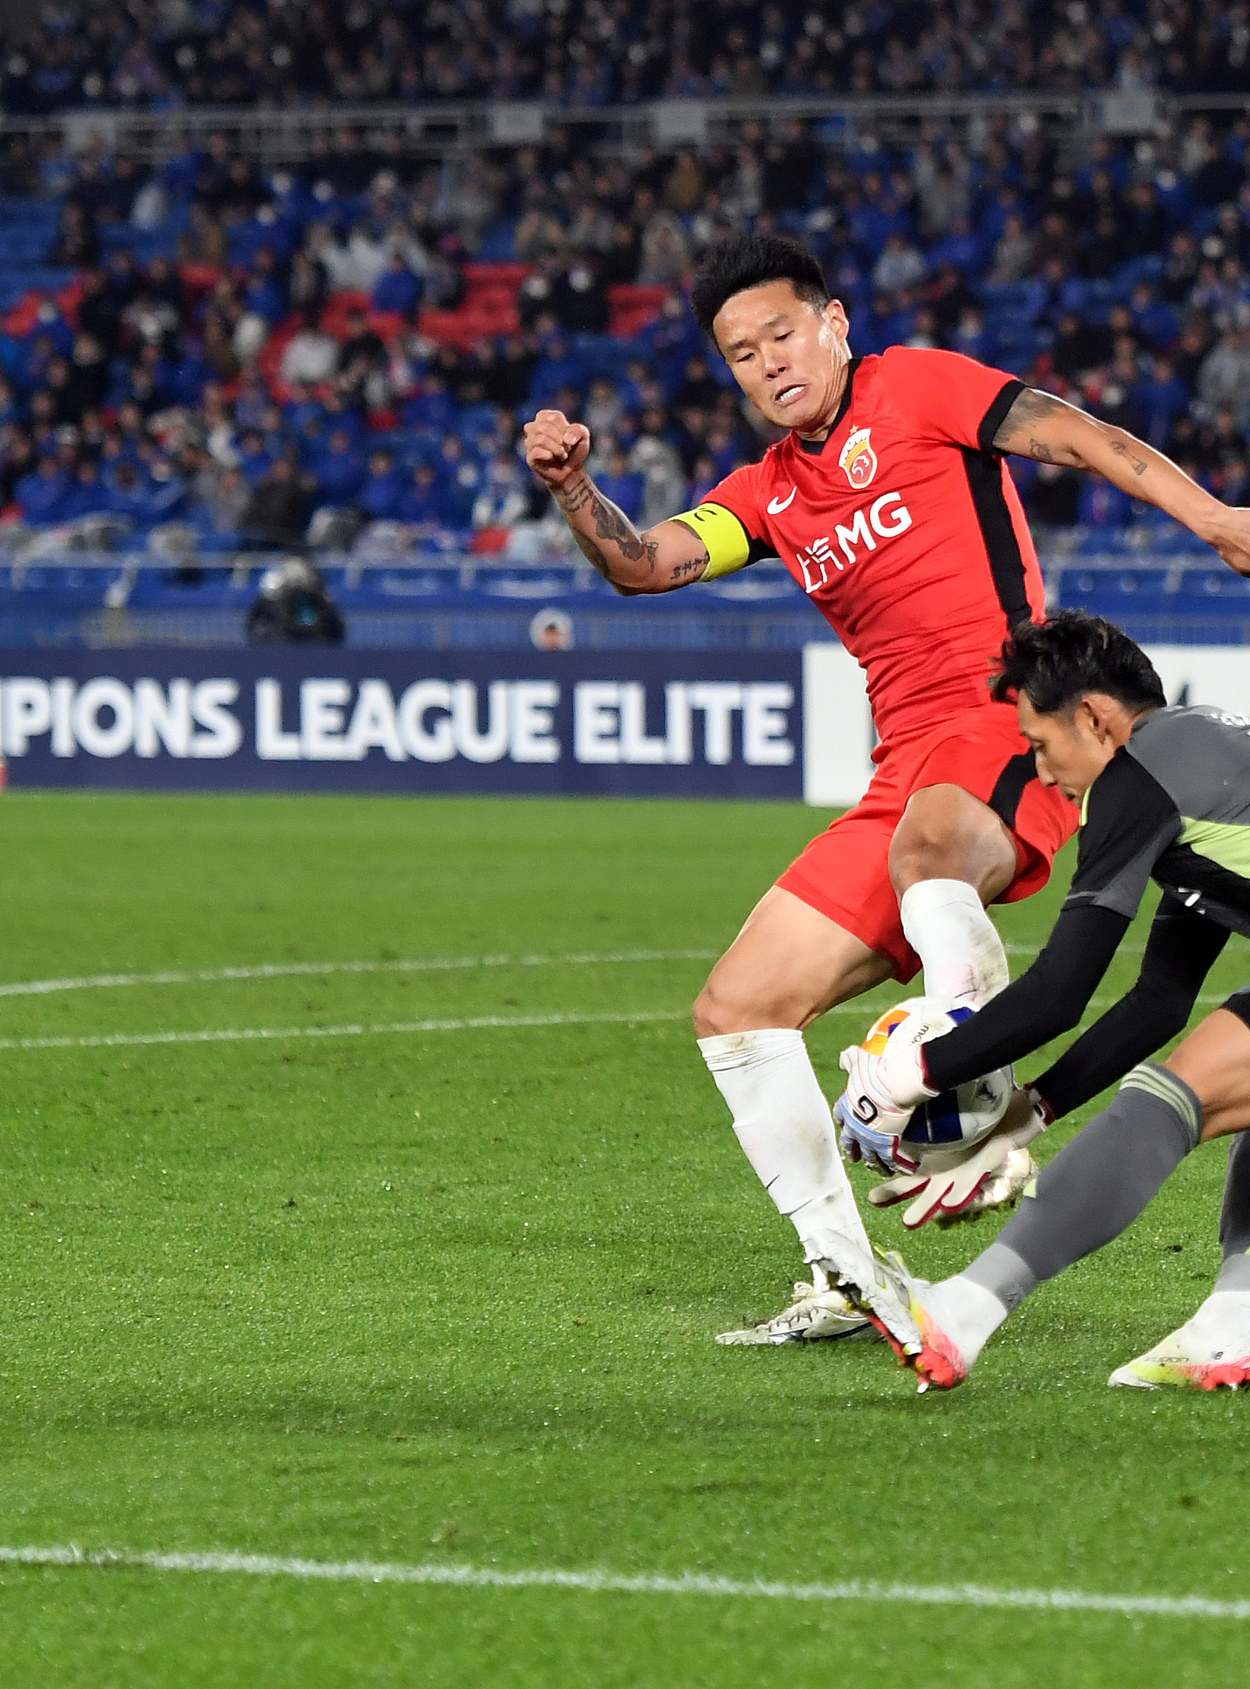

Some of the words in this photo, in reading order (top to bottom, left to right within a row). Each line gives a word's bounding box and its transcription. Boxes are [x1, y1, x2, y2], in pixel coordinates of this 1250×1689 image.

[0, 676, 241, 759] PIONS
[255, 678, 560, 763] LEAGUE
[574, 680, 795, 766] ELITE
